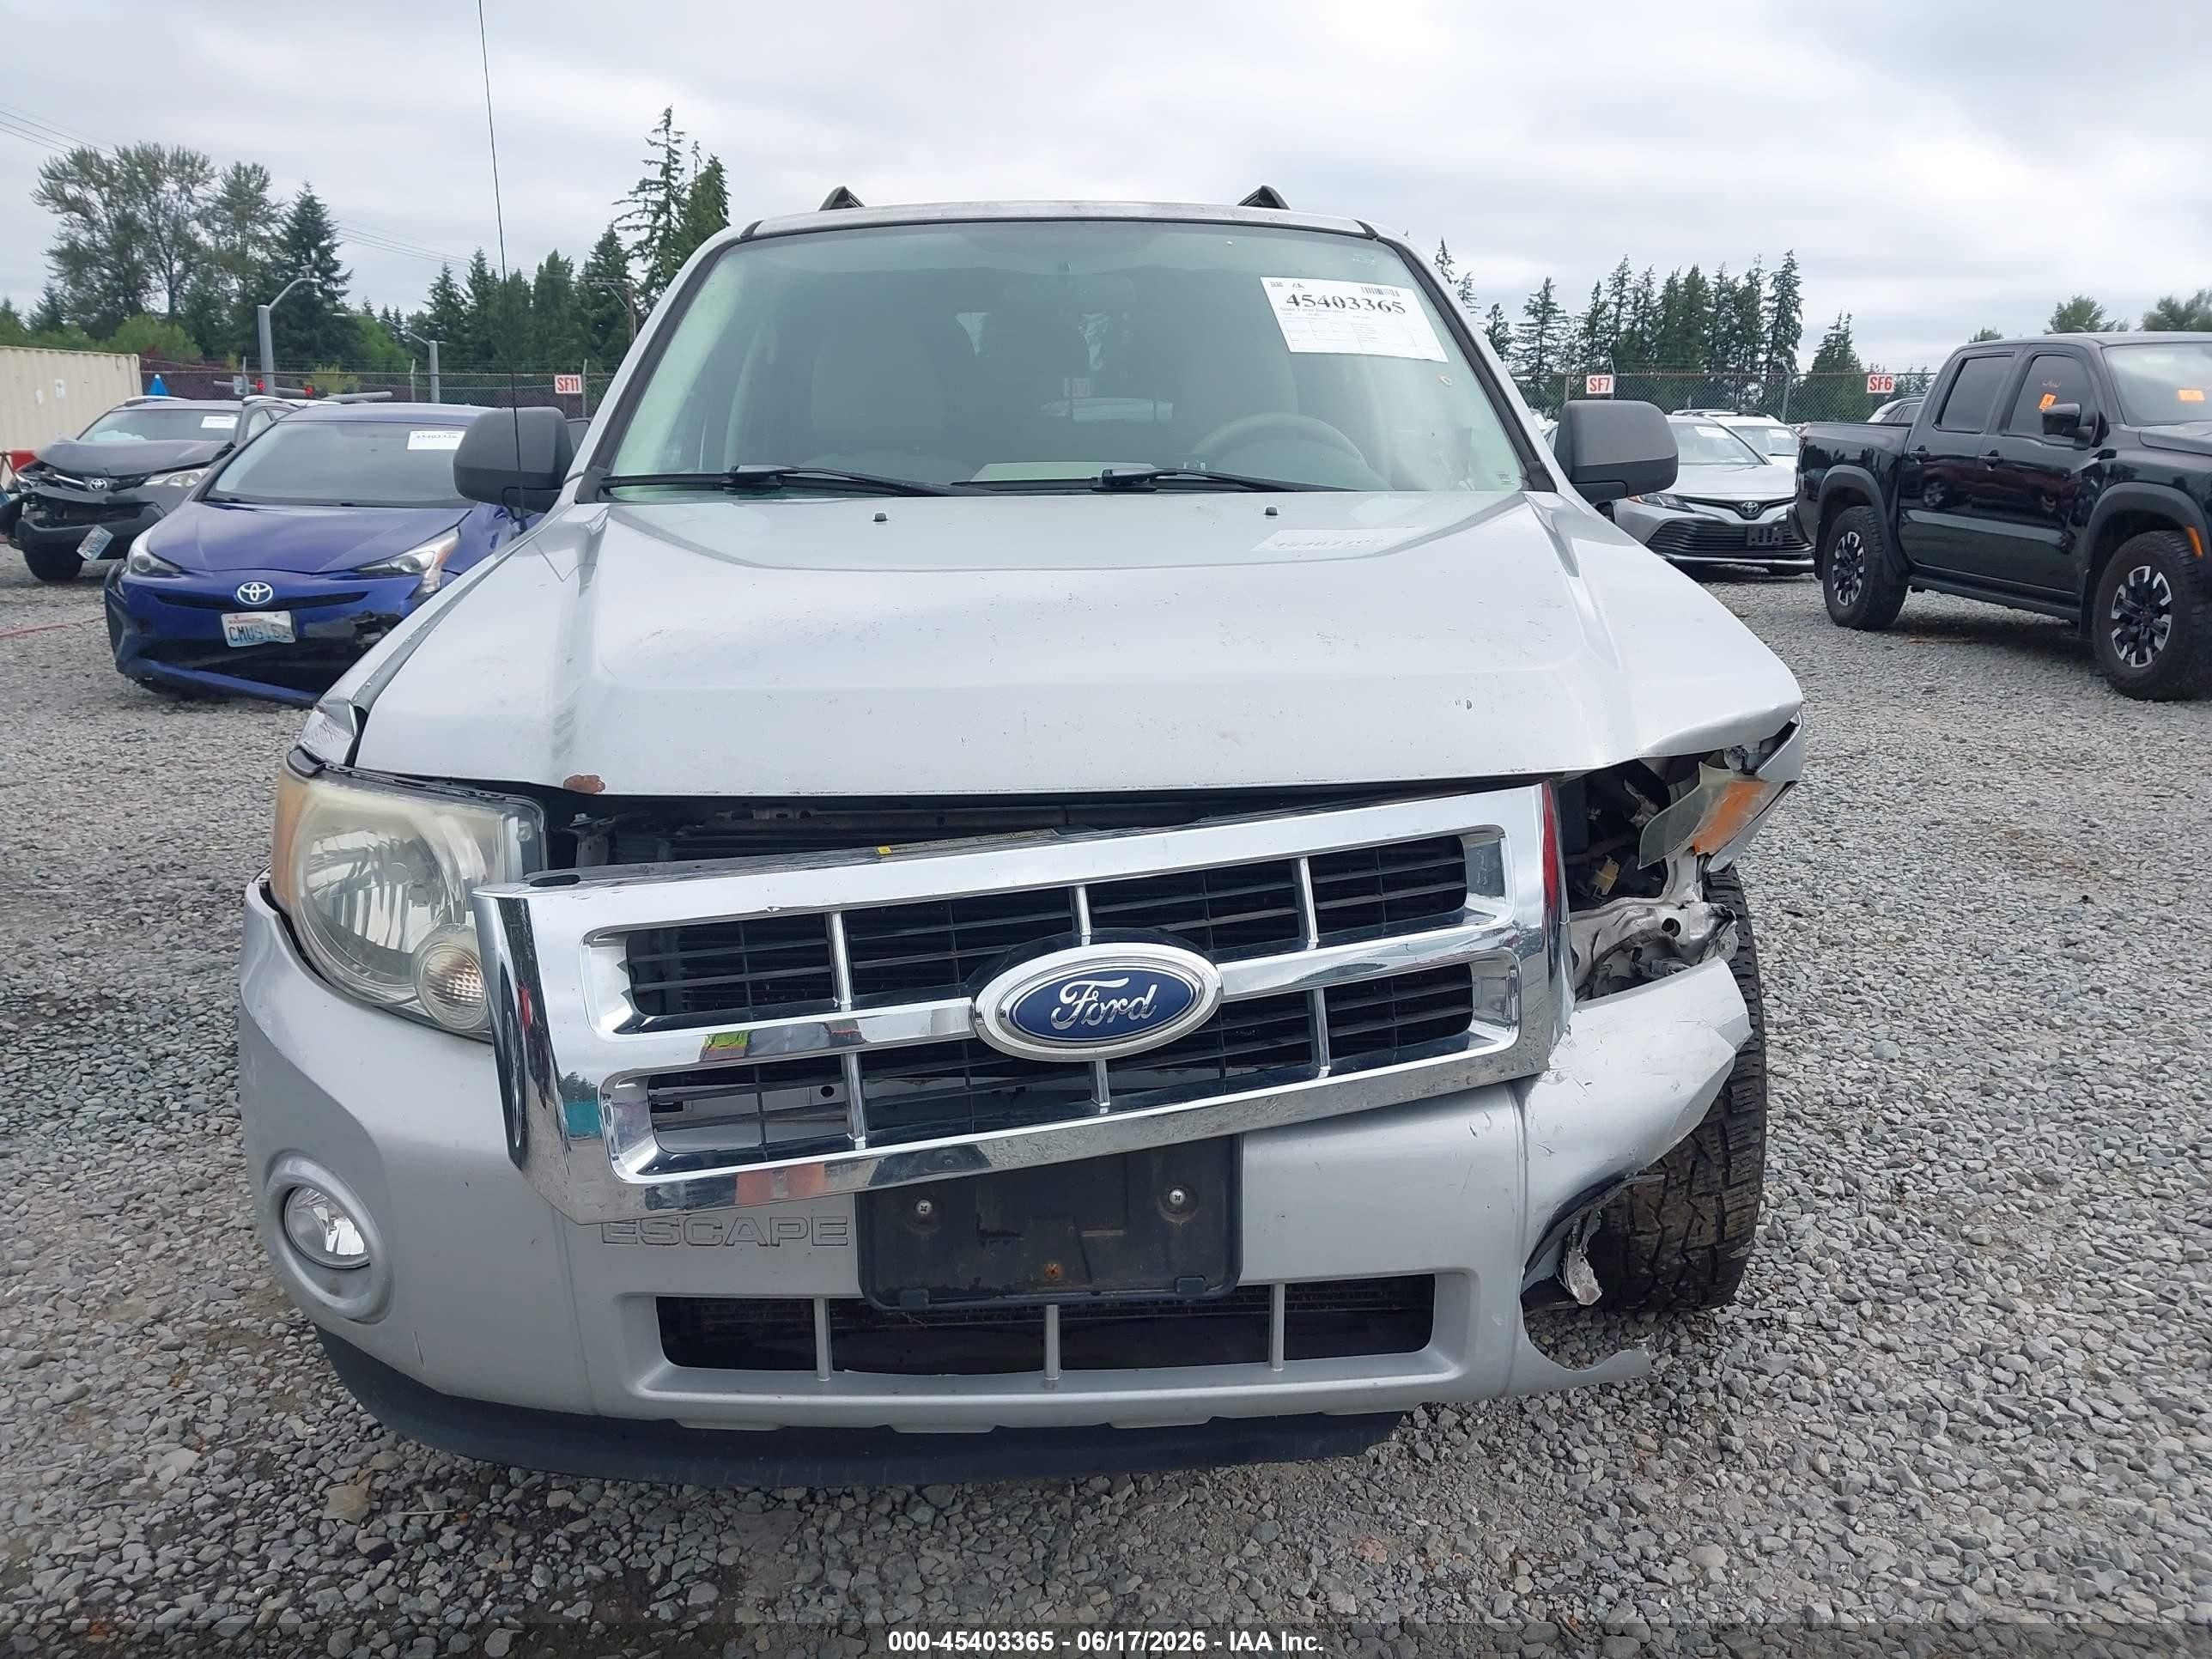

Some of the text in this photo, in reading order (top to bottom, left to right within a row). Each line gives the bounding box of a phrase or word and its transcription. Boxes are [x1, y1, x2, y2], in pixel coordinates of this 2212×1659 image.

[1286, 293, 1406, 314] 45403365
[557, 376, 579, 392] SF11
[1589, 377, 1611, 392] SF7
[1869, 376, 1893, 392] SF6
[1050, 976, 1158, 1030] Ford
[601, 1216, 848, 1247] ESCAPE
